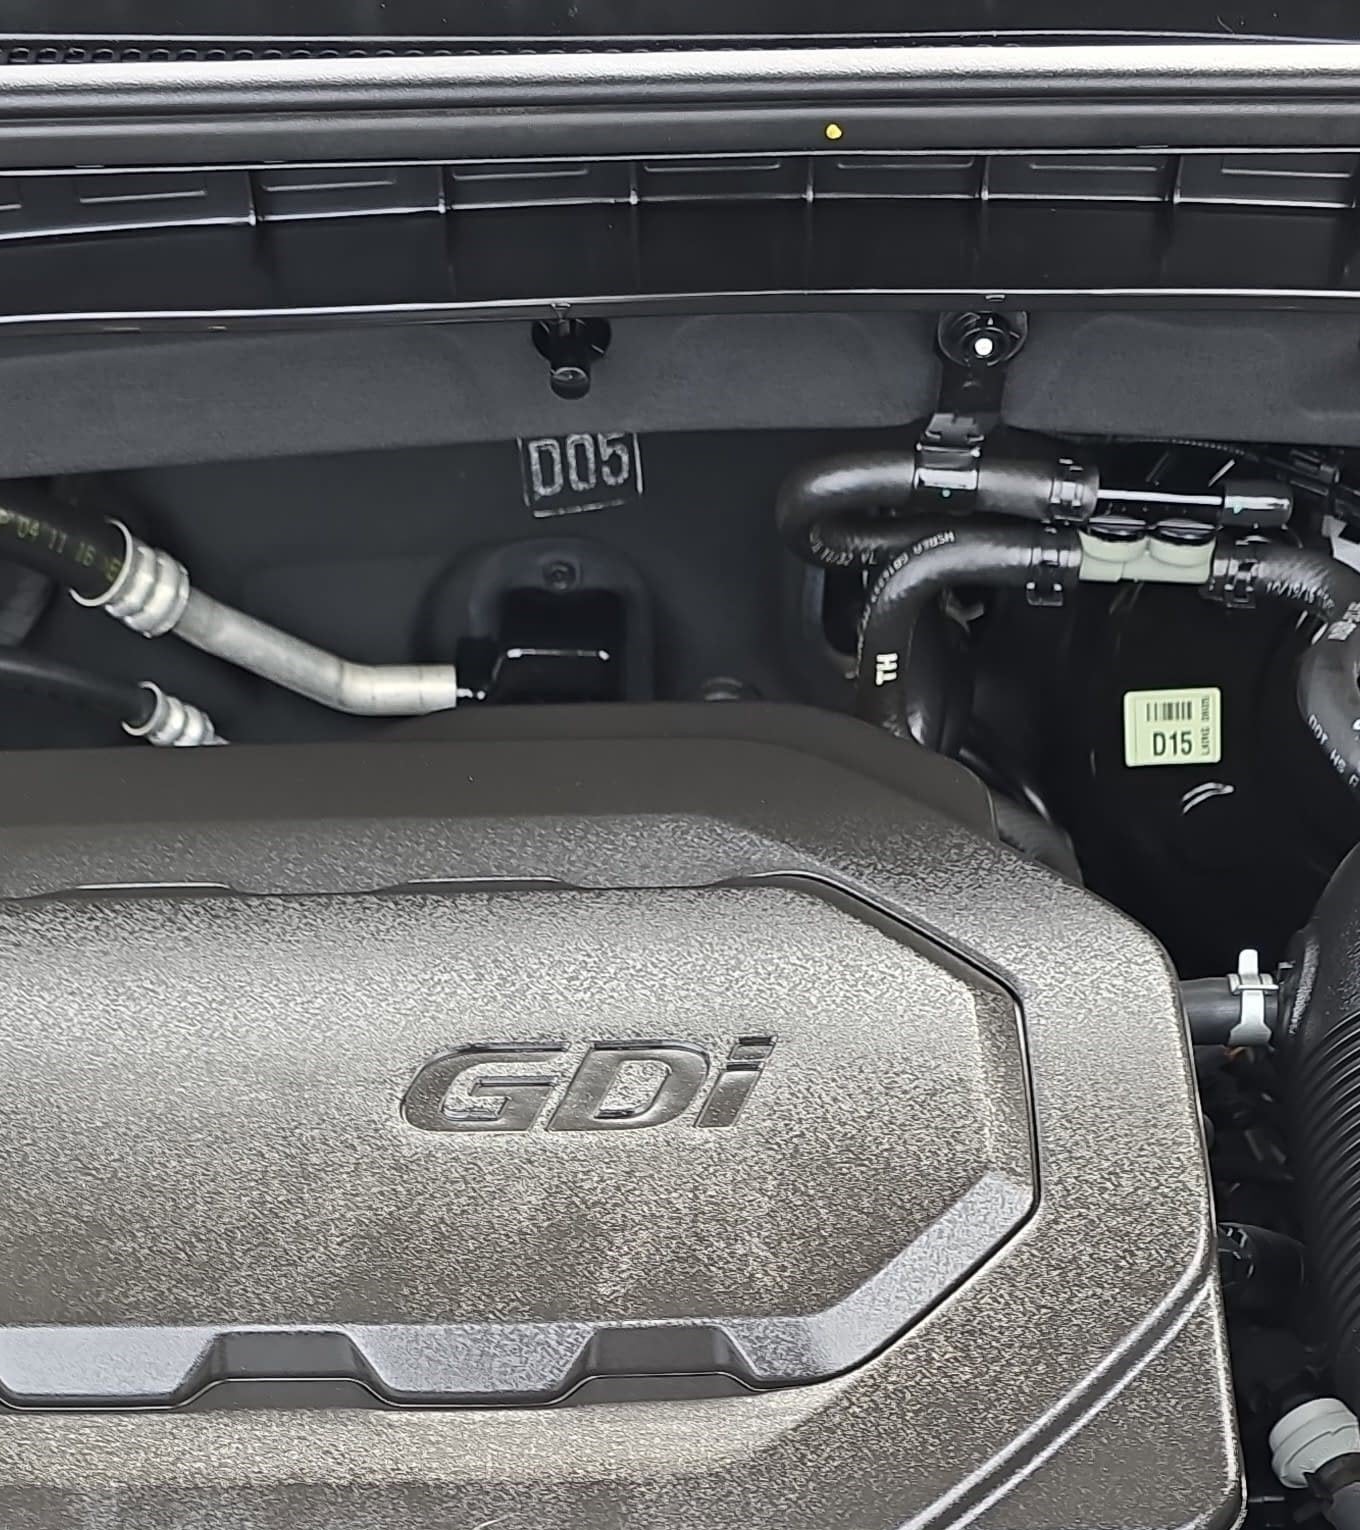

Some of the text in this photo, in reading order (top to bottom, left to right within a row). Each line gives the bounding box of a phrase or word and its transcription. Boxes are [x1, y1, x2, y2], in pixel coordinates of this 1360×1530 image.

[529, 432, 629, 498] D05
[1153, 730, 1193, 757] D15
[400, 1034, 778, 1133] GDi
